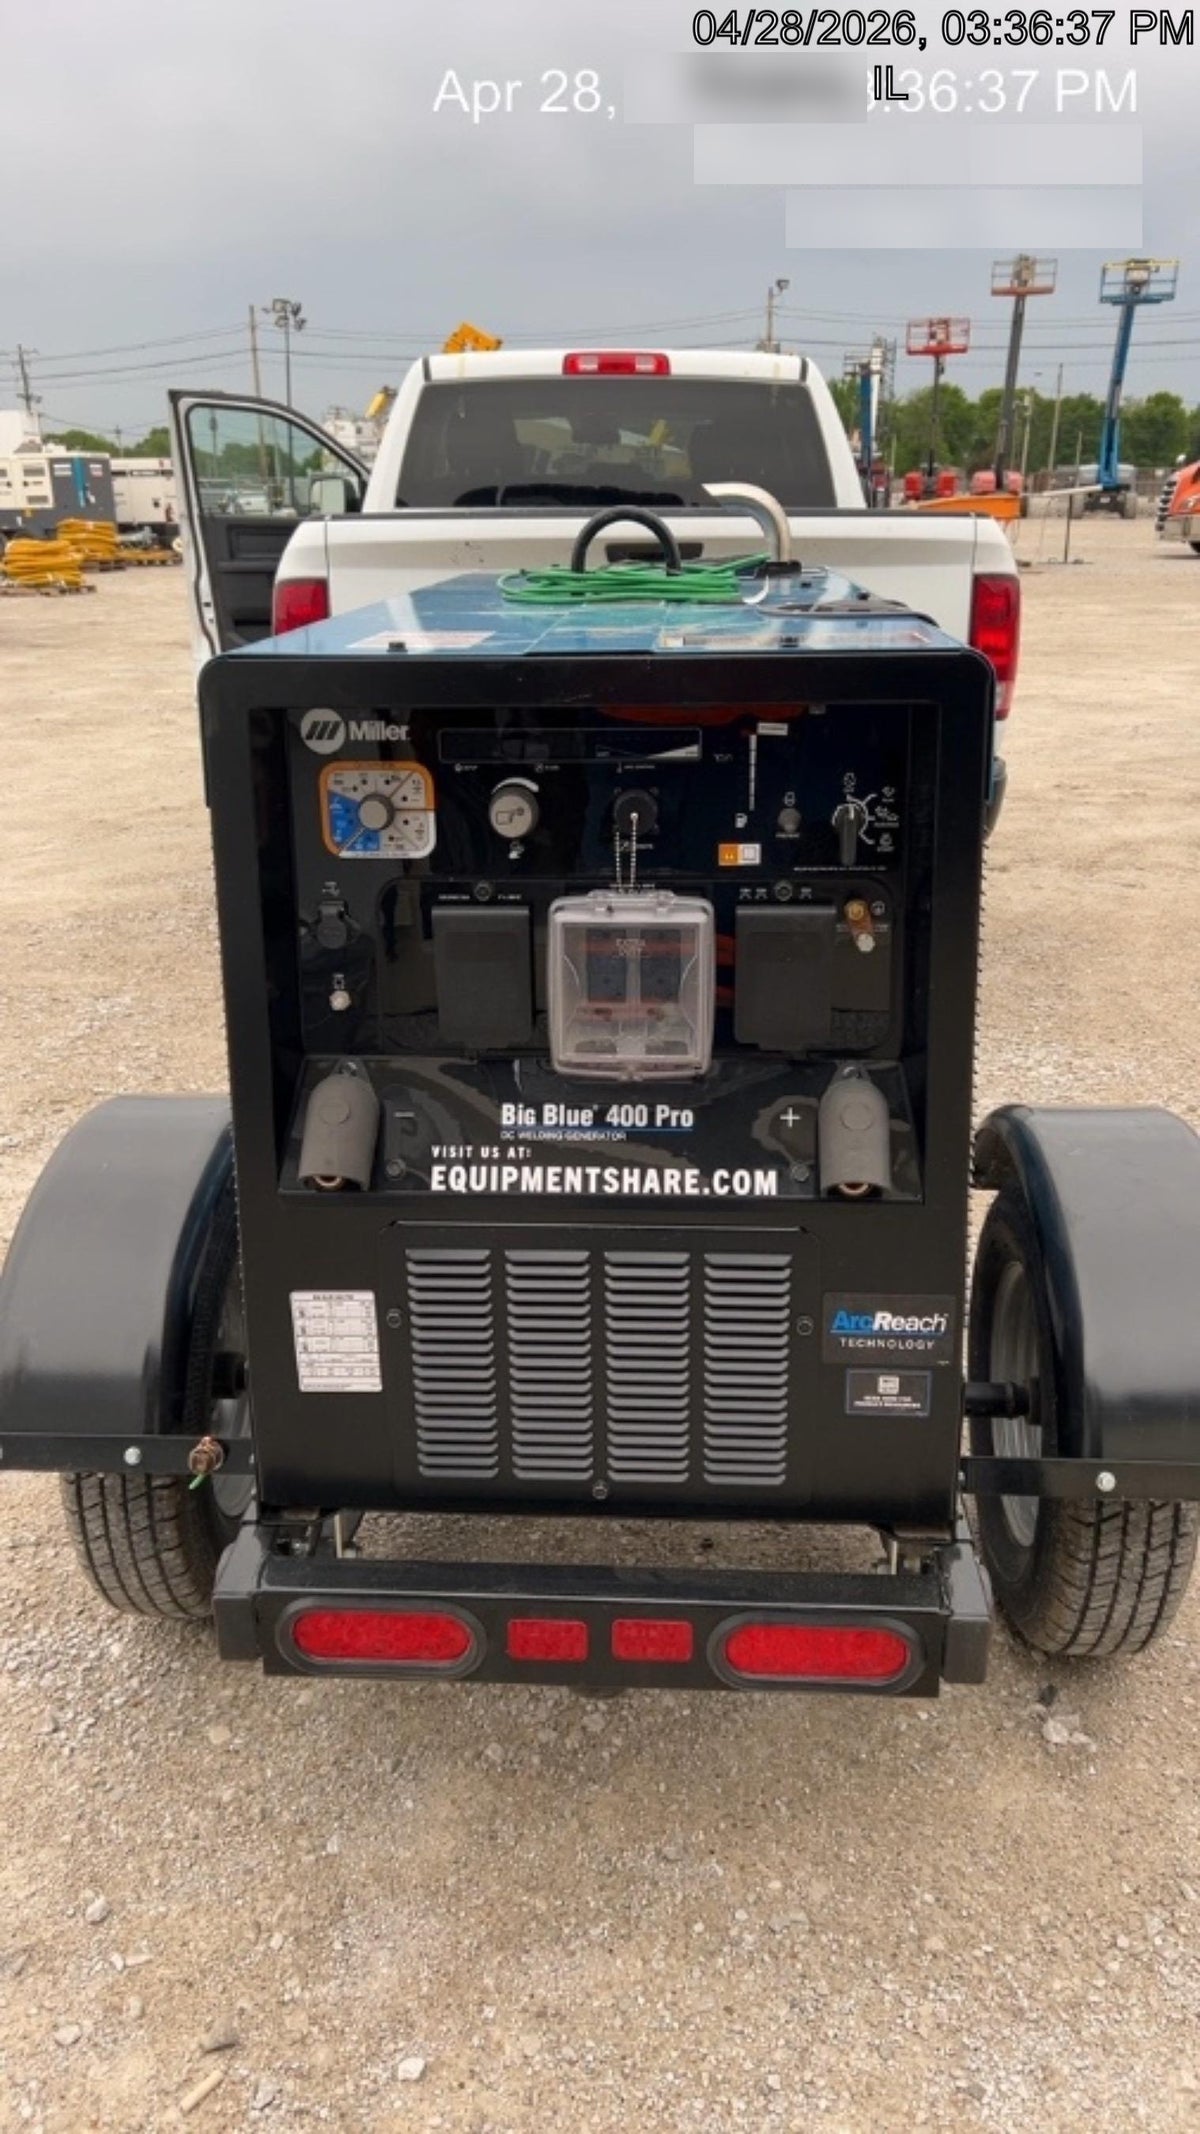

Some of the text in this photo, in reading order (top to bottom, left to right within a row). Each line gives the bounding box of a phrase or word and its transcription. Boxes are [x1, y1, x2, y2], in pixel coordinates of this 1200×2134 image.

[348, 720, 410, 742] Miller
[502, 1103, 694, 1128] Big Blue 400 Pro
[518, 1130, 563, 1142] WELDING
[431, 1145, 533, 1159] VISIT US AT:
[431, 1164, 779, 1196] EQUIPMENTSHARE.COM
[832, 1309, 947, 1333] ArcReach
[840, 1336, 936, 1351] TECHNOLOGY
